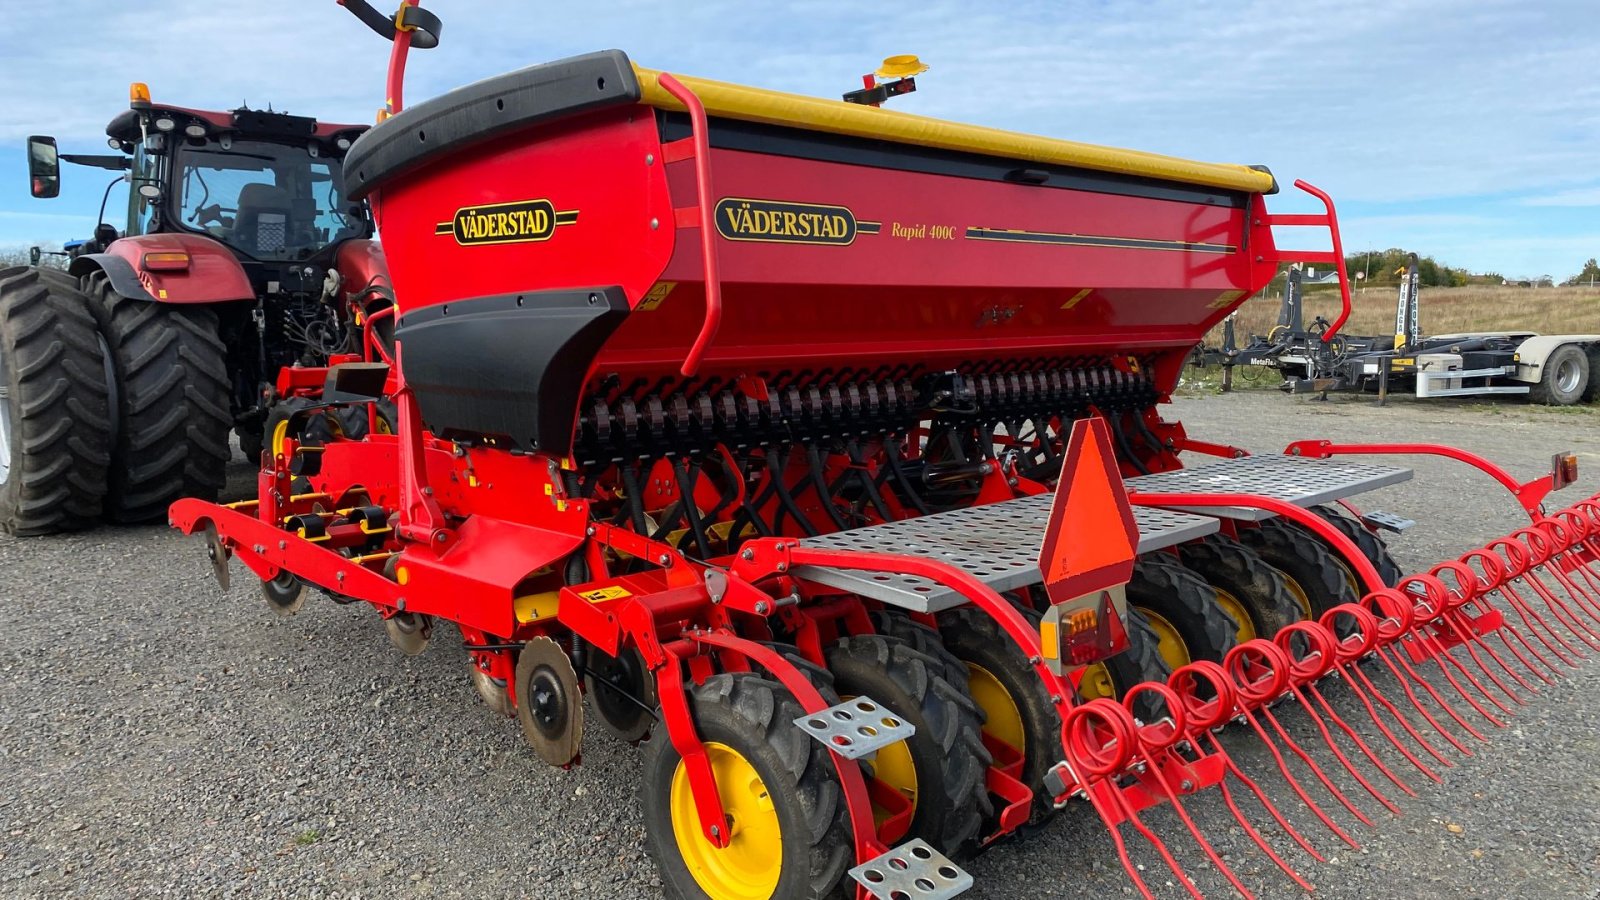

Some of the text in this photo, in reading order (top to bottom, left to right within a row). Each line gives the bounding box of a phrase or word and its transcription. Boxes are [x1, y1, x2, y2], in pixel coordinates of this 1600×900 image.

[460, 210, 548, 238] VÄDERSTAD
[725, 203, 848, 238] VÄDERSTAD
[892, 222, 957, 240] Rapid 400C
